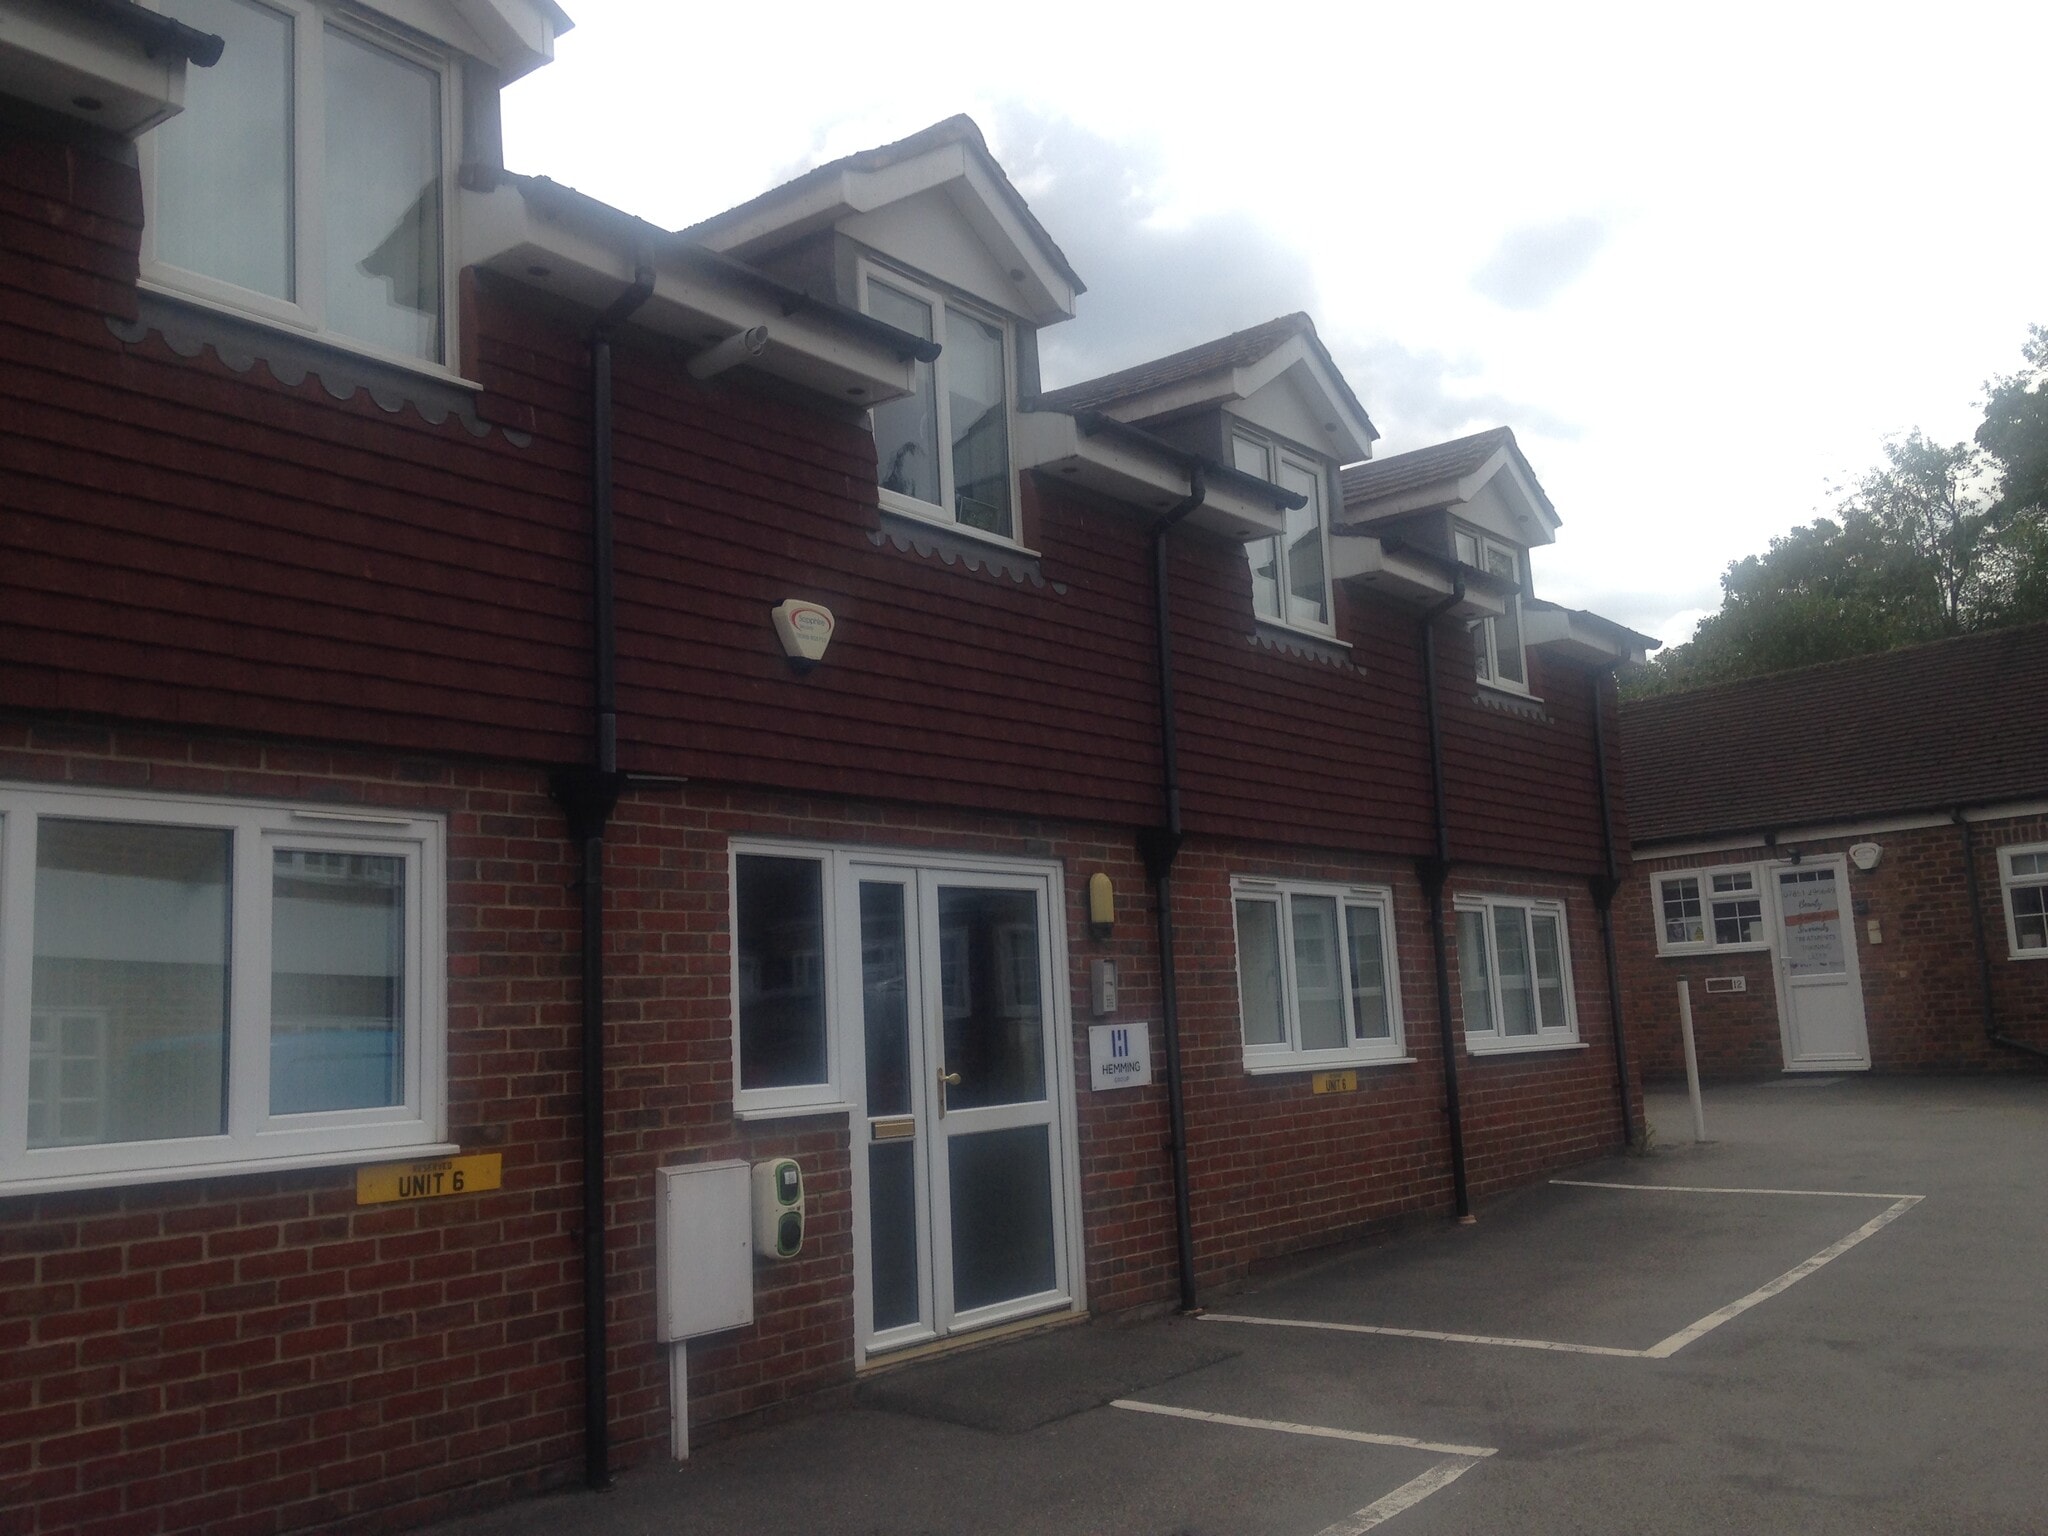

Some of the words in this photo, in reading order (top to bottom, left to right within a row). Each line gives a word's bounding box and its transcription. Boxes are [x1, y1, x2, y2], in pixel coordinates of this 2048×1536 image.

[1733, 980, 1743, 989] 12
[1102, 1060, 1141, 1075] HEMMING
[1325, 1079, 1340, 1091] UNIT
[1342, 1078, 1346, 1090] 6
[412, 1161, 453, 1173] RESERVED
[399, 1172, 444, 1197] UNIT
[452, 1170, 464, 1192] 6
